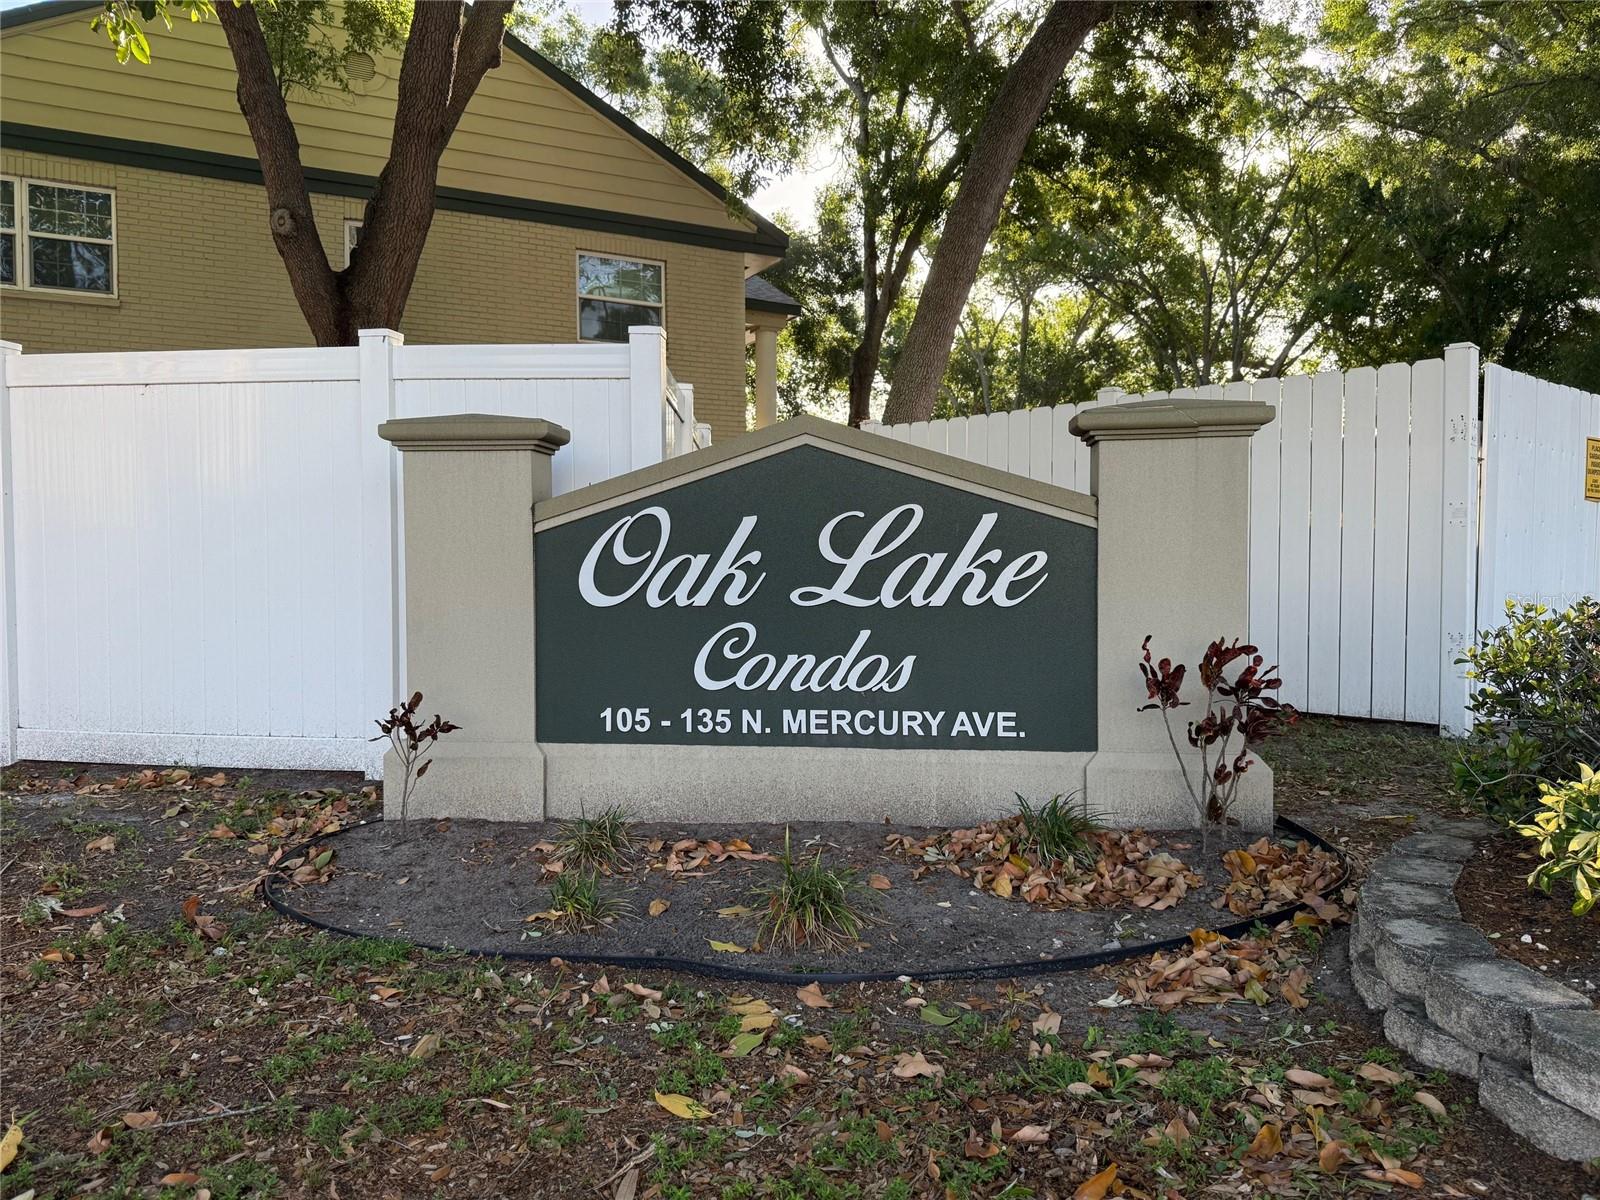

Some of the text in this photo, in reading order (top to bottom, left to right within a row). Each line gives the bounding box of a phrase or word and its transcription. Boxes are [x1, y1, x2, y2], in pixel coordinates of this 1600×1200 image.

[578, 503, 1049, 609] Oak Lake
[693, 621, 917, 694] Condos
[600, 707, 651, 733] 105
[680, 708, 732, 734] 135
[742, 709, 771, 735] N.
[782, 709, 946, 737] MERCURY
[950, 711, 1026, 739] AVE.
